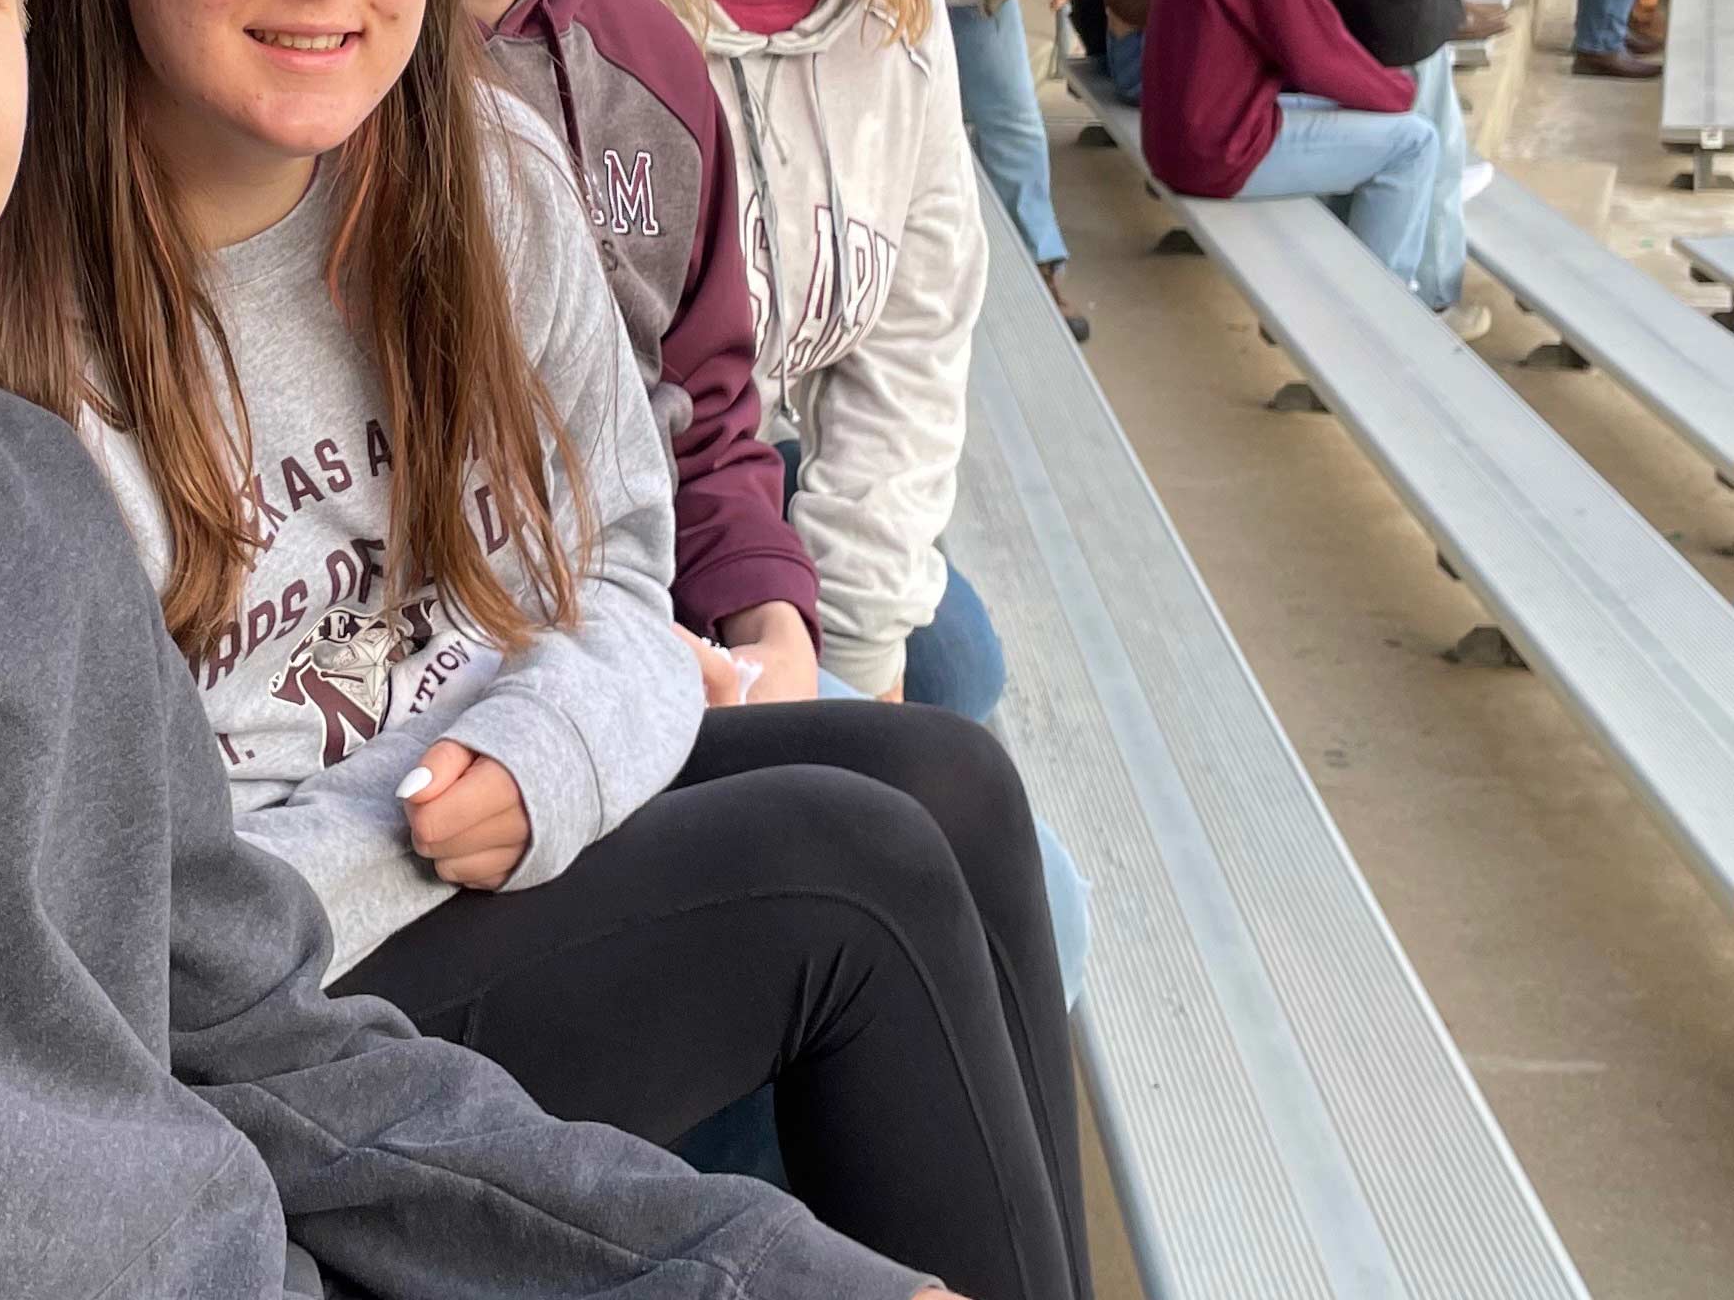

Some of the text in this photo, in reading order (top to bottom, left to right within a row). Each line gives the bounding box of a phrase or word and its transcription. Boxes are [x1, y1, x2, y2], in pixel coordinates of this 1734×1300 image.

[238, 437, 353, 573] XAS
[188, 579, 308, 692] RPS
[325, 538, 385, 606] OF
[409, 639, 472, 714] TION
